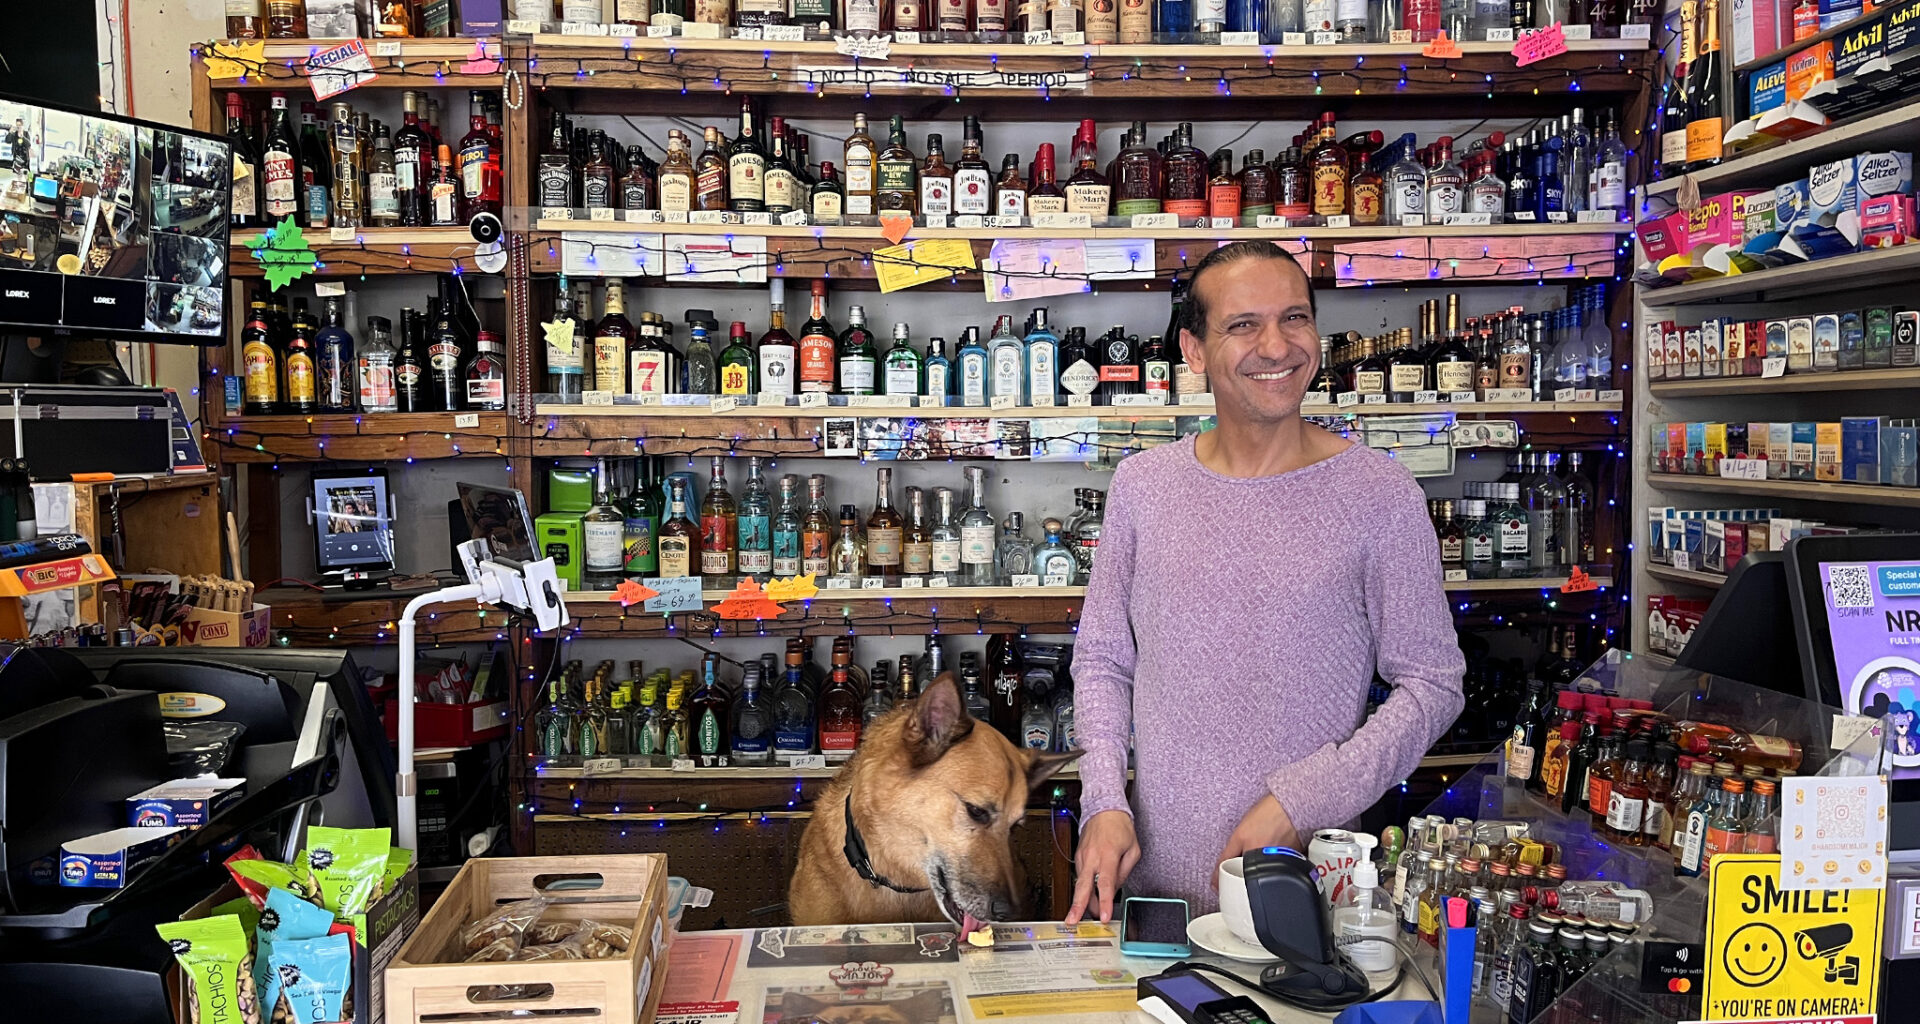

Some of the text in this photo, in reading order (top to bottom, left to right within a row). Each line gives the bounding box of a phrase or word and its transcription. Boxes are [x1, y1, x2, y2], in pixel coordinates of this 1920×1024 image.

[1841, 22, 1884, 57] Advil
[822, 71, 846, 84] NO
[905, 71, 976, 86] NO SALE
[1006, 73, 1068, 87] PERIOD
[1754, 70, 1786, 94] ALEVE
[731, 154, 765, 168] JAMESON
[1862, 158, 1894, 174] Alka-
[766, 172, 793, 182] JAMESON
[1314, 166, 1346, 180] FIREBALL
[1811, 167, 1841, 190] Seltzer
[1860, 166, 1901, 182] Seltzer
[1072, 187, 1108, 196] Maker's
[1546, 188, 1563, 198] SKYY
[1081, 195, 1107, 204] Mark
[1688, 200, 1721, 222] Pepto
[5, 289, 30, 298] LOREX
[93, 296, 116, 305] LOREX
[800, 339, 833, 350] JAMESON
[1503, 355, 1526, 364] Tito's
[637, 361, 660, 392] 7
[1771, 453, 1788, 461] SPIRIT
[1794, 453, 1811, 461] SPIRIT
[1818, 455, 1836, 464] SPIRIT
[47, 534, 79, 545] TORCH
[57, 542, 77, 552] GUN
[37, 570, 56, 581] BIC
[1886, 570, 1917, 580] Special
[1838, 606, 1875, 618] SCAN ME
[203, 625, 226, 638] CONE
[1889, 637, 1909, 645] FULL
[141, 818, 164, 827] TUMS
[66, 869, 84, 877] TUMS
[1741, 874, 1849, 914] SMILE!
[374, 886, 416, 942] PISTACHIOS
[1660, 966, 1704, 976] Tap & go with
[1721, 997, 1858, 1018] YOU'RE ON CAMERA
